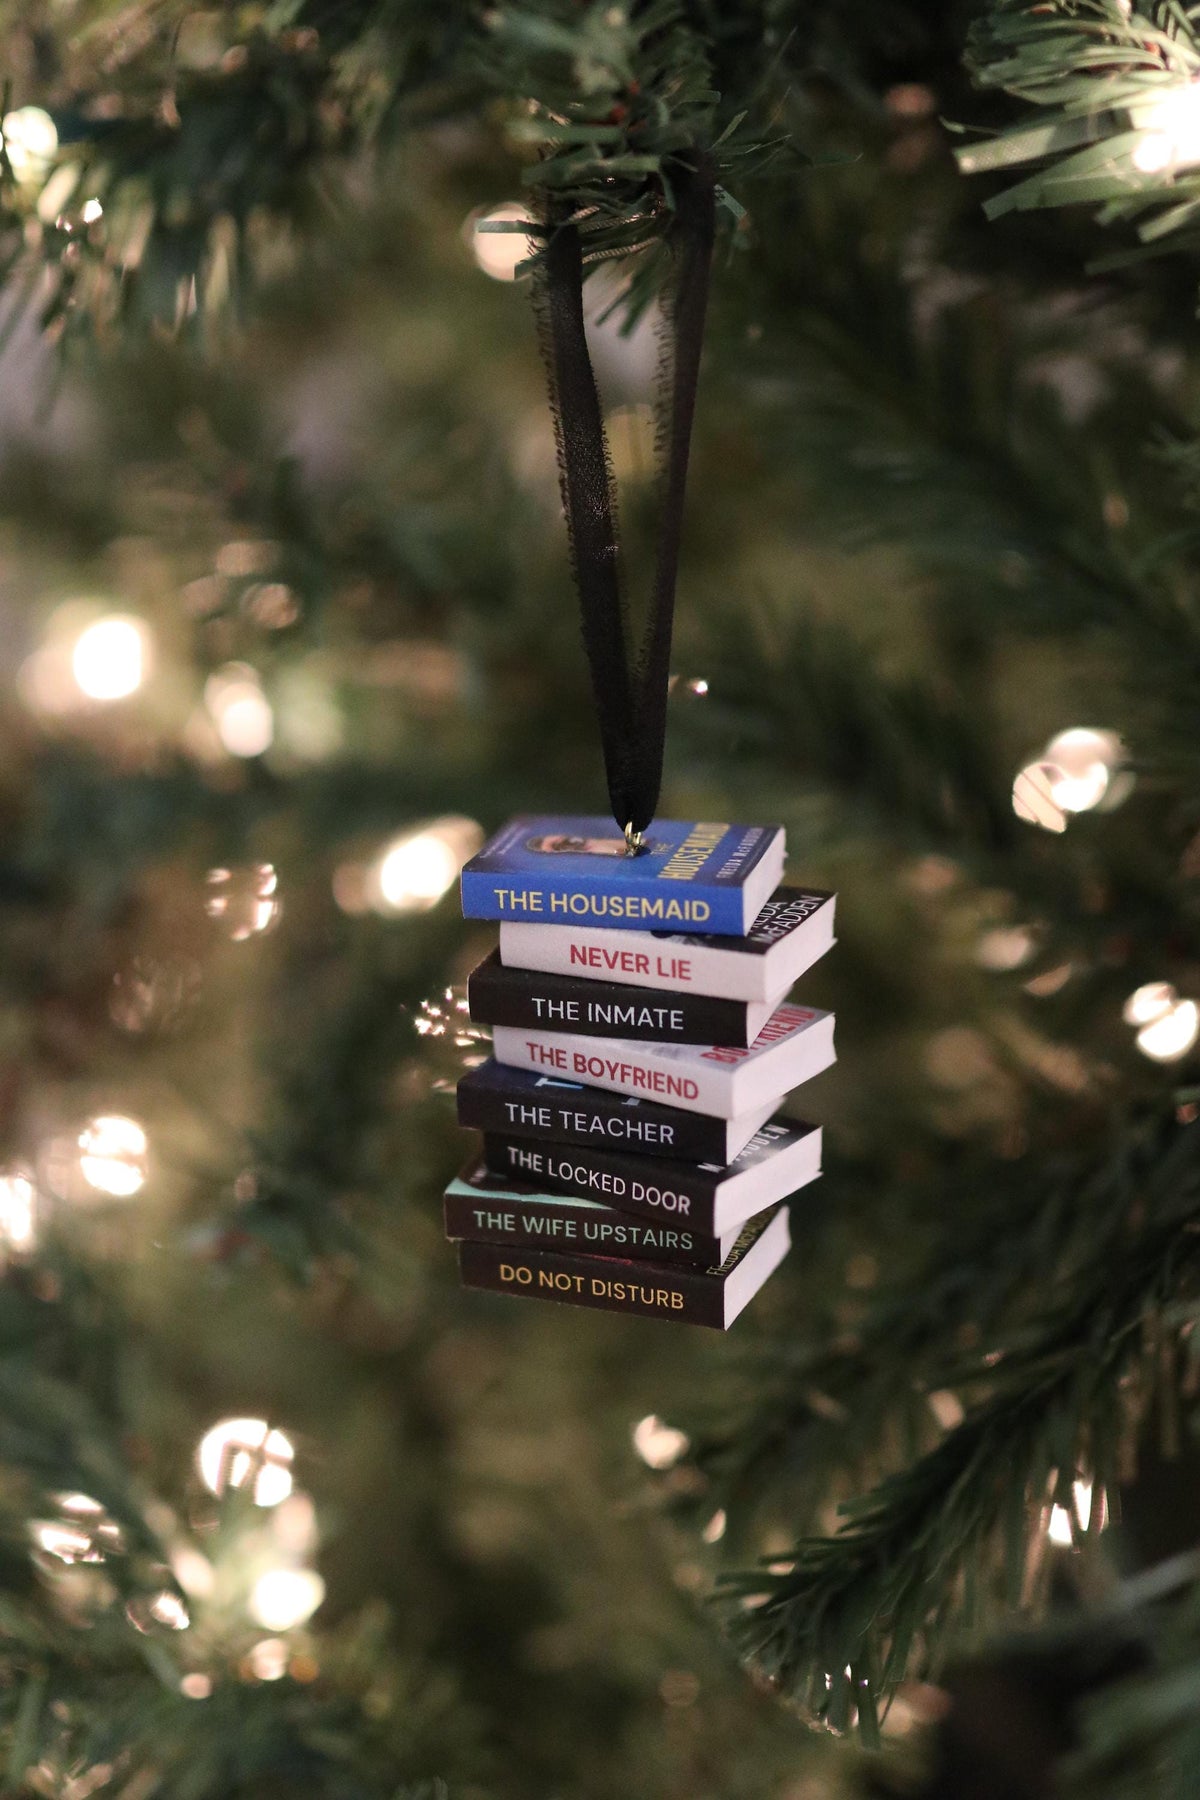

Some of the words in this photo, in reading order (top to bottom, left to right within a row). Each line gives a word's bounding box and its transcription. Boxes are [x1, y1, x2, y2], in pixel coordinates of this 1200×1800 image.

[493, 888, 544, 912] THE
[550, 891, 711, 922] HOUSEMAID
[569, 944, 649, 975] NEVER
[657, 956, 692, 981] LIE
[531, 997, 579, 1021] THE
[587, 1002, 684, 1030] INMATE
[525, 1042, 569, 1069] THE
[572, 1050, 700, 1100] BOYFRIEND
[504, 1102, 552, 1127] THE
[559, 1110, 675, 1145] TEACHER
[507, 1146, 543, 1173] THE
[547, 1157, 627, 1196] LOCKED
[631, 1182, 692, 1216] DOOR
[472, 1210, 516, 1232] THE
[521, 1214, 578, 1239] WIFE
[583, 1222, 694, 1250] UPSTAIRS
[499, 1263, 532, 1285] DO
[538, 1269, 586, 1293] NOT
[592, 1279, 685, 1310] DISTURB
